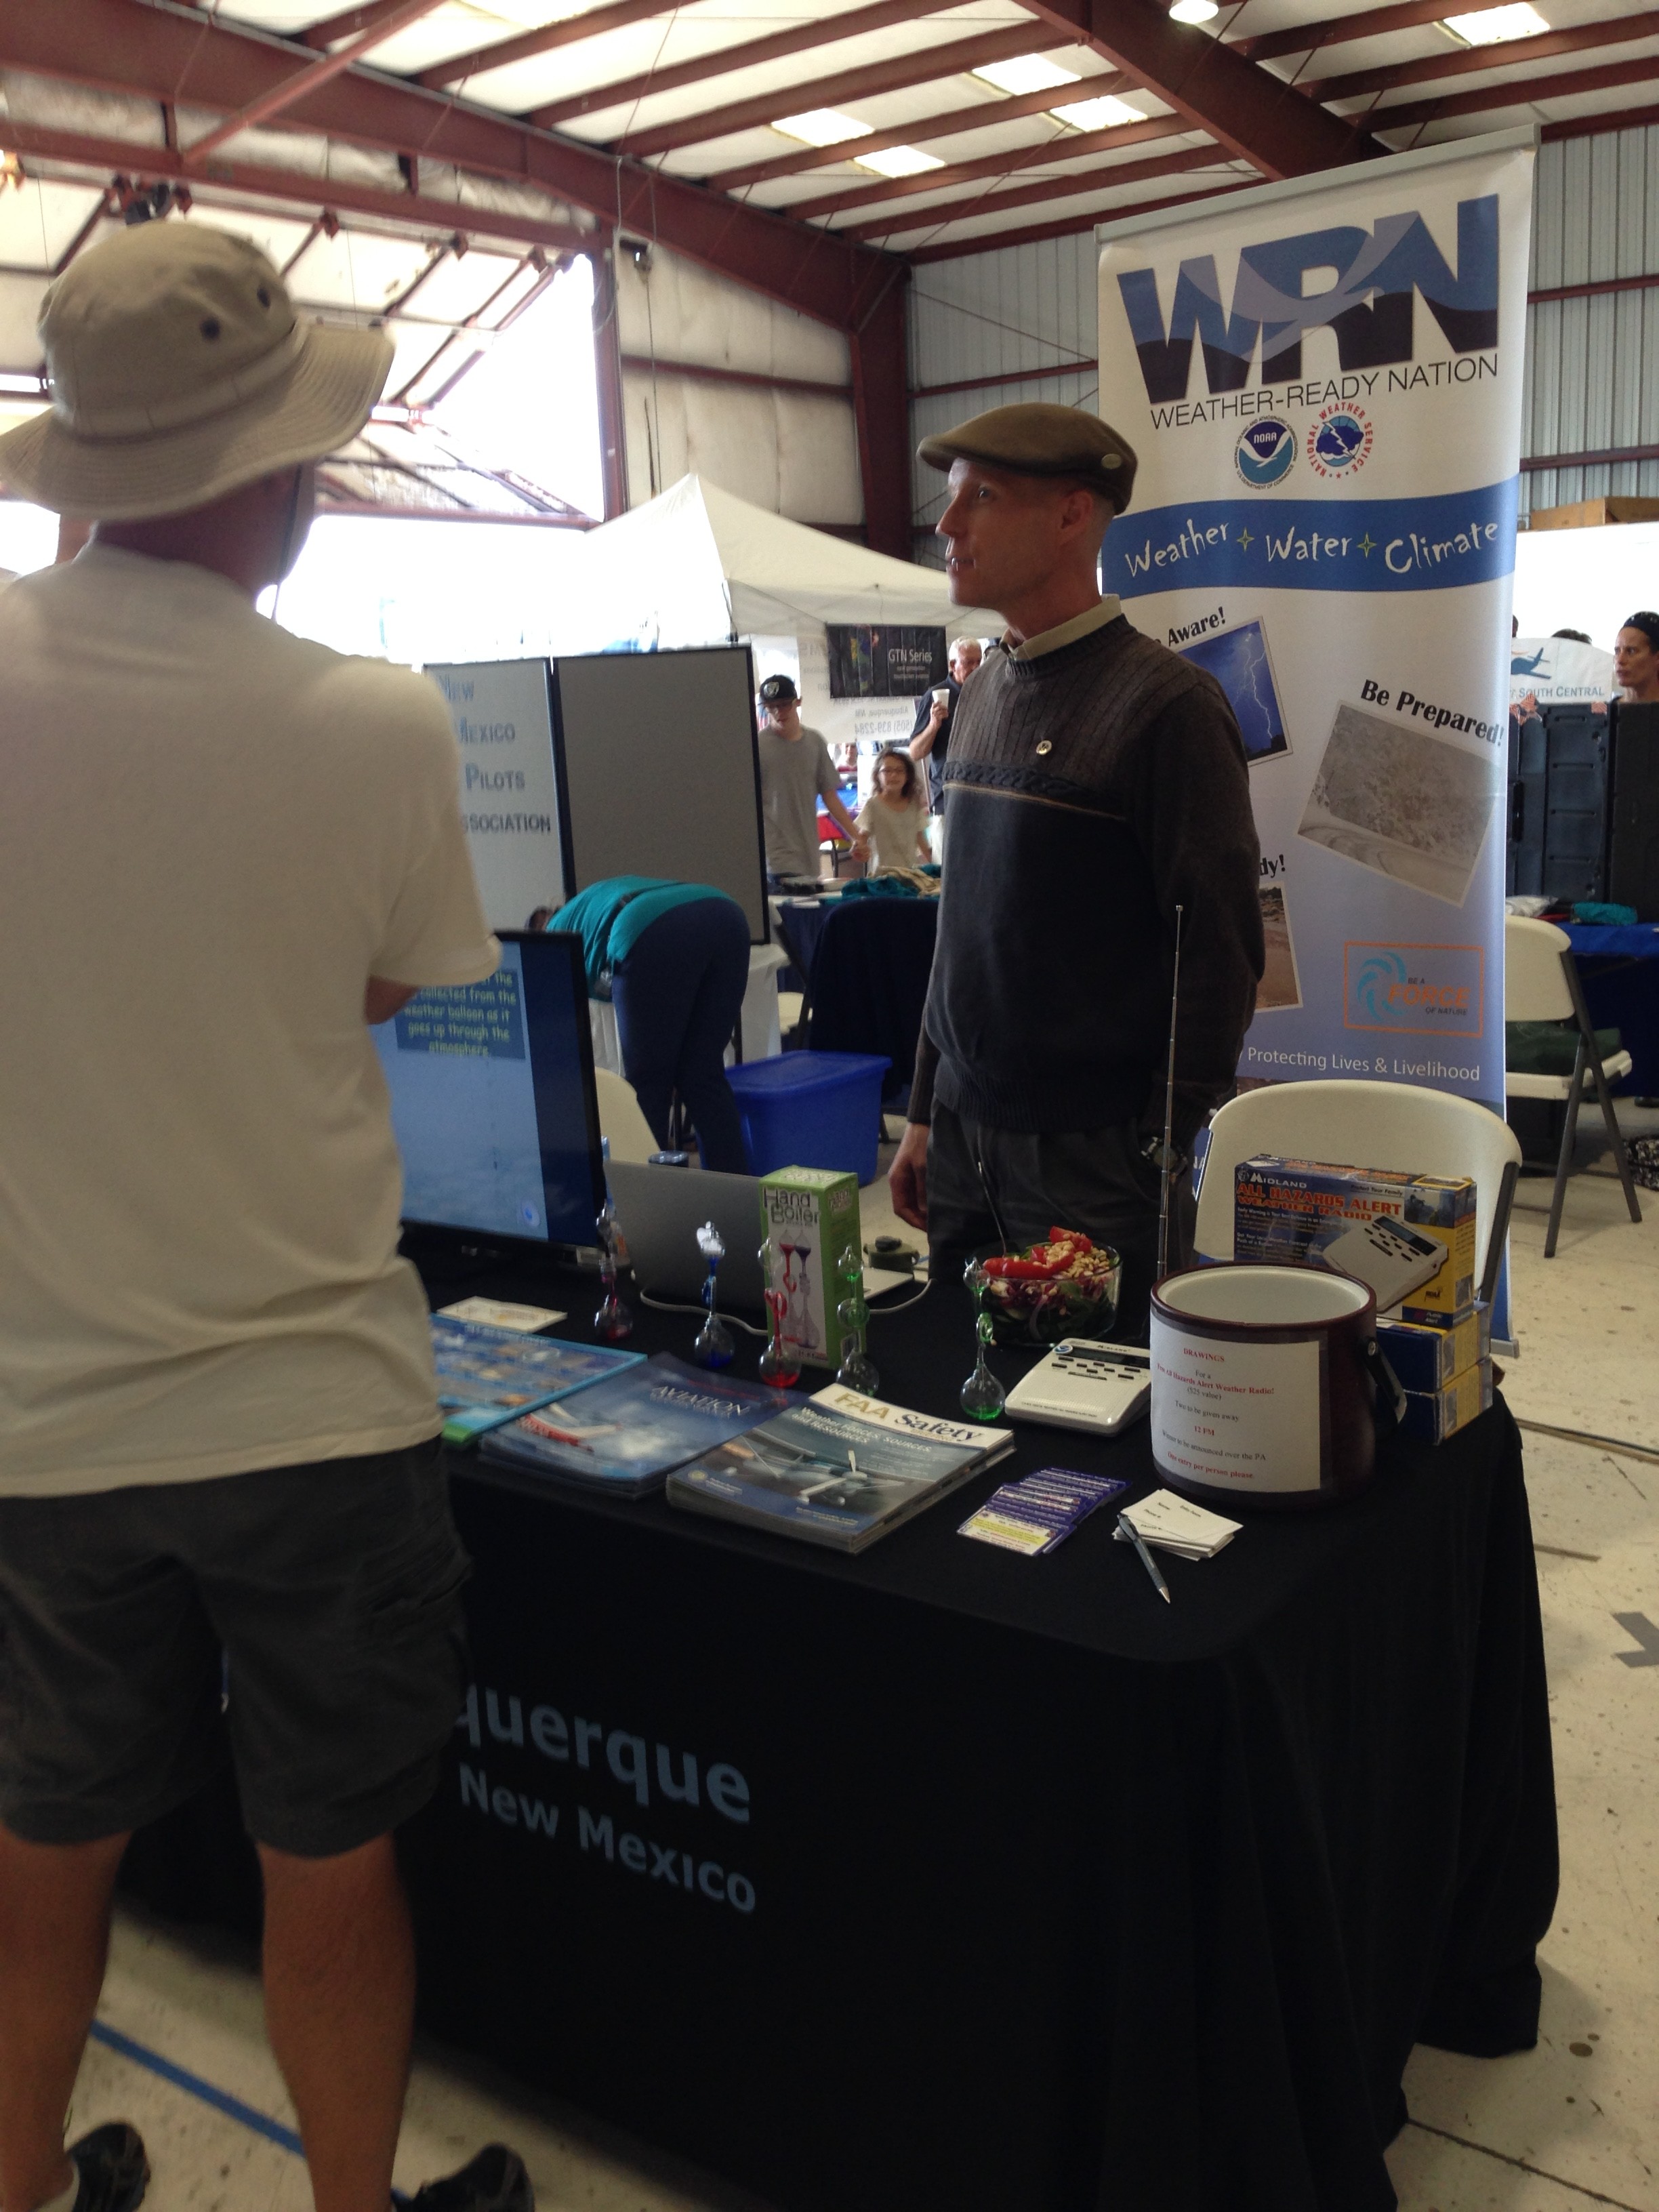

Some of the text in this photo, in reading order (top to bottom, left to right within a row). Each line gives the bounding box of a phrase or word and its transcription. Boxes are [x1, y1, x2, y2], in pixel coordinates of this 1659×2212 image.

[1117, 193, 1498, 404] WRN
[1151, 354, 1498, 430] WEATHER-READY NATION
[1254, 432, 1277, 444] NOAA
[1307, 402, 1372, 477] NATIONAL WEATHER SERVICE
[1125, 518, 1498, 577] Weather Water Climate
[1168, 607, 1226, 647] Aware!
[888, 649, 933, 663] GTN Series
[1556, 685, 1604, 697] CENTRAL
[1360, 679, 1505, 746] Be Prepared!
[470, 987, 495, 1004] from
[498, 989, 516, 1006] the
[1387, 983, 1471, 1008] FORCE
[448, 1004, 484, 1022] balloon
[487, 1009, 498, 1023] as
[501, 1008, 510, 1024] it
[1437, 1008, 1467, 1016] NATURE
[409, 1021, 510, 1044] goes up through the
[1248, 1048, 1327, 1071] Protecting
[1332, 1054, 1369, 1071] Lives
[1375, 1058, 1388, 1073] &
[1393, 1060, 1479, 1081] Livelihood
[762, 1187, 811, 1210] Hand
[1237, 1183, 1401, 1215] ALL HAZARDS ALERT
[1385, 1189, 1403, 1197] Family
[771, 1202, 821, 1225] Boiler
[1238, 1196, 1372, 1221] WEATHER RADIO
[1183, 1348, 1225, 1362] DRAWINGS
[1173, 1372, 1195, 1385] Hazards
[1197, 1380, 1213, 1389] Alert
[1216, 1383, 1246, 1394] Weather
[1195, 1370, 1206, 1378] For
[1202, 1391, 1221, 1401] value)
[832, 1391, 889, 1420] FAA
[894, 1412, 984, 1443] Safety
[1175, 1400, 1186, 1410] Two
[1203, 1410, 1220, 1419] given
[1222, 1414, 1239, 1422] away
[1194, 1425, 1215, 1436] 12 PM
[1183, 1440, 1189, 1448] be
[1191, 1444, 1223, 1457] announced
[1254, 1453, 1266, 1461] PA
[1178, 1456, 1191, 1468] entry
[1193, 1462, 1203, 1471] per
[1206, 1467, 1228, 1476] person
[456, 1683, 750, 1824] querque
[459, 1762, 756, 1914] New Mexico
